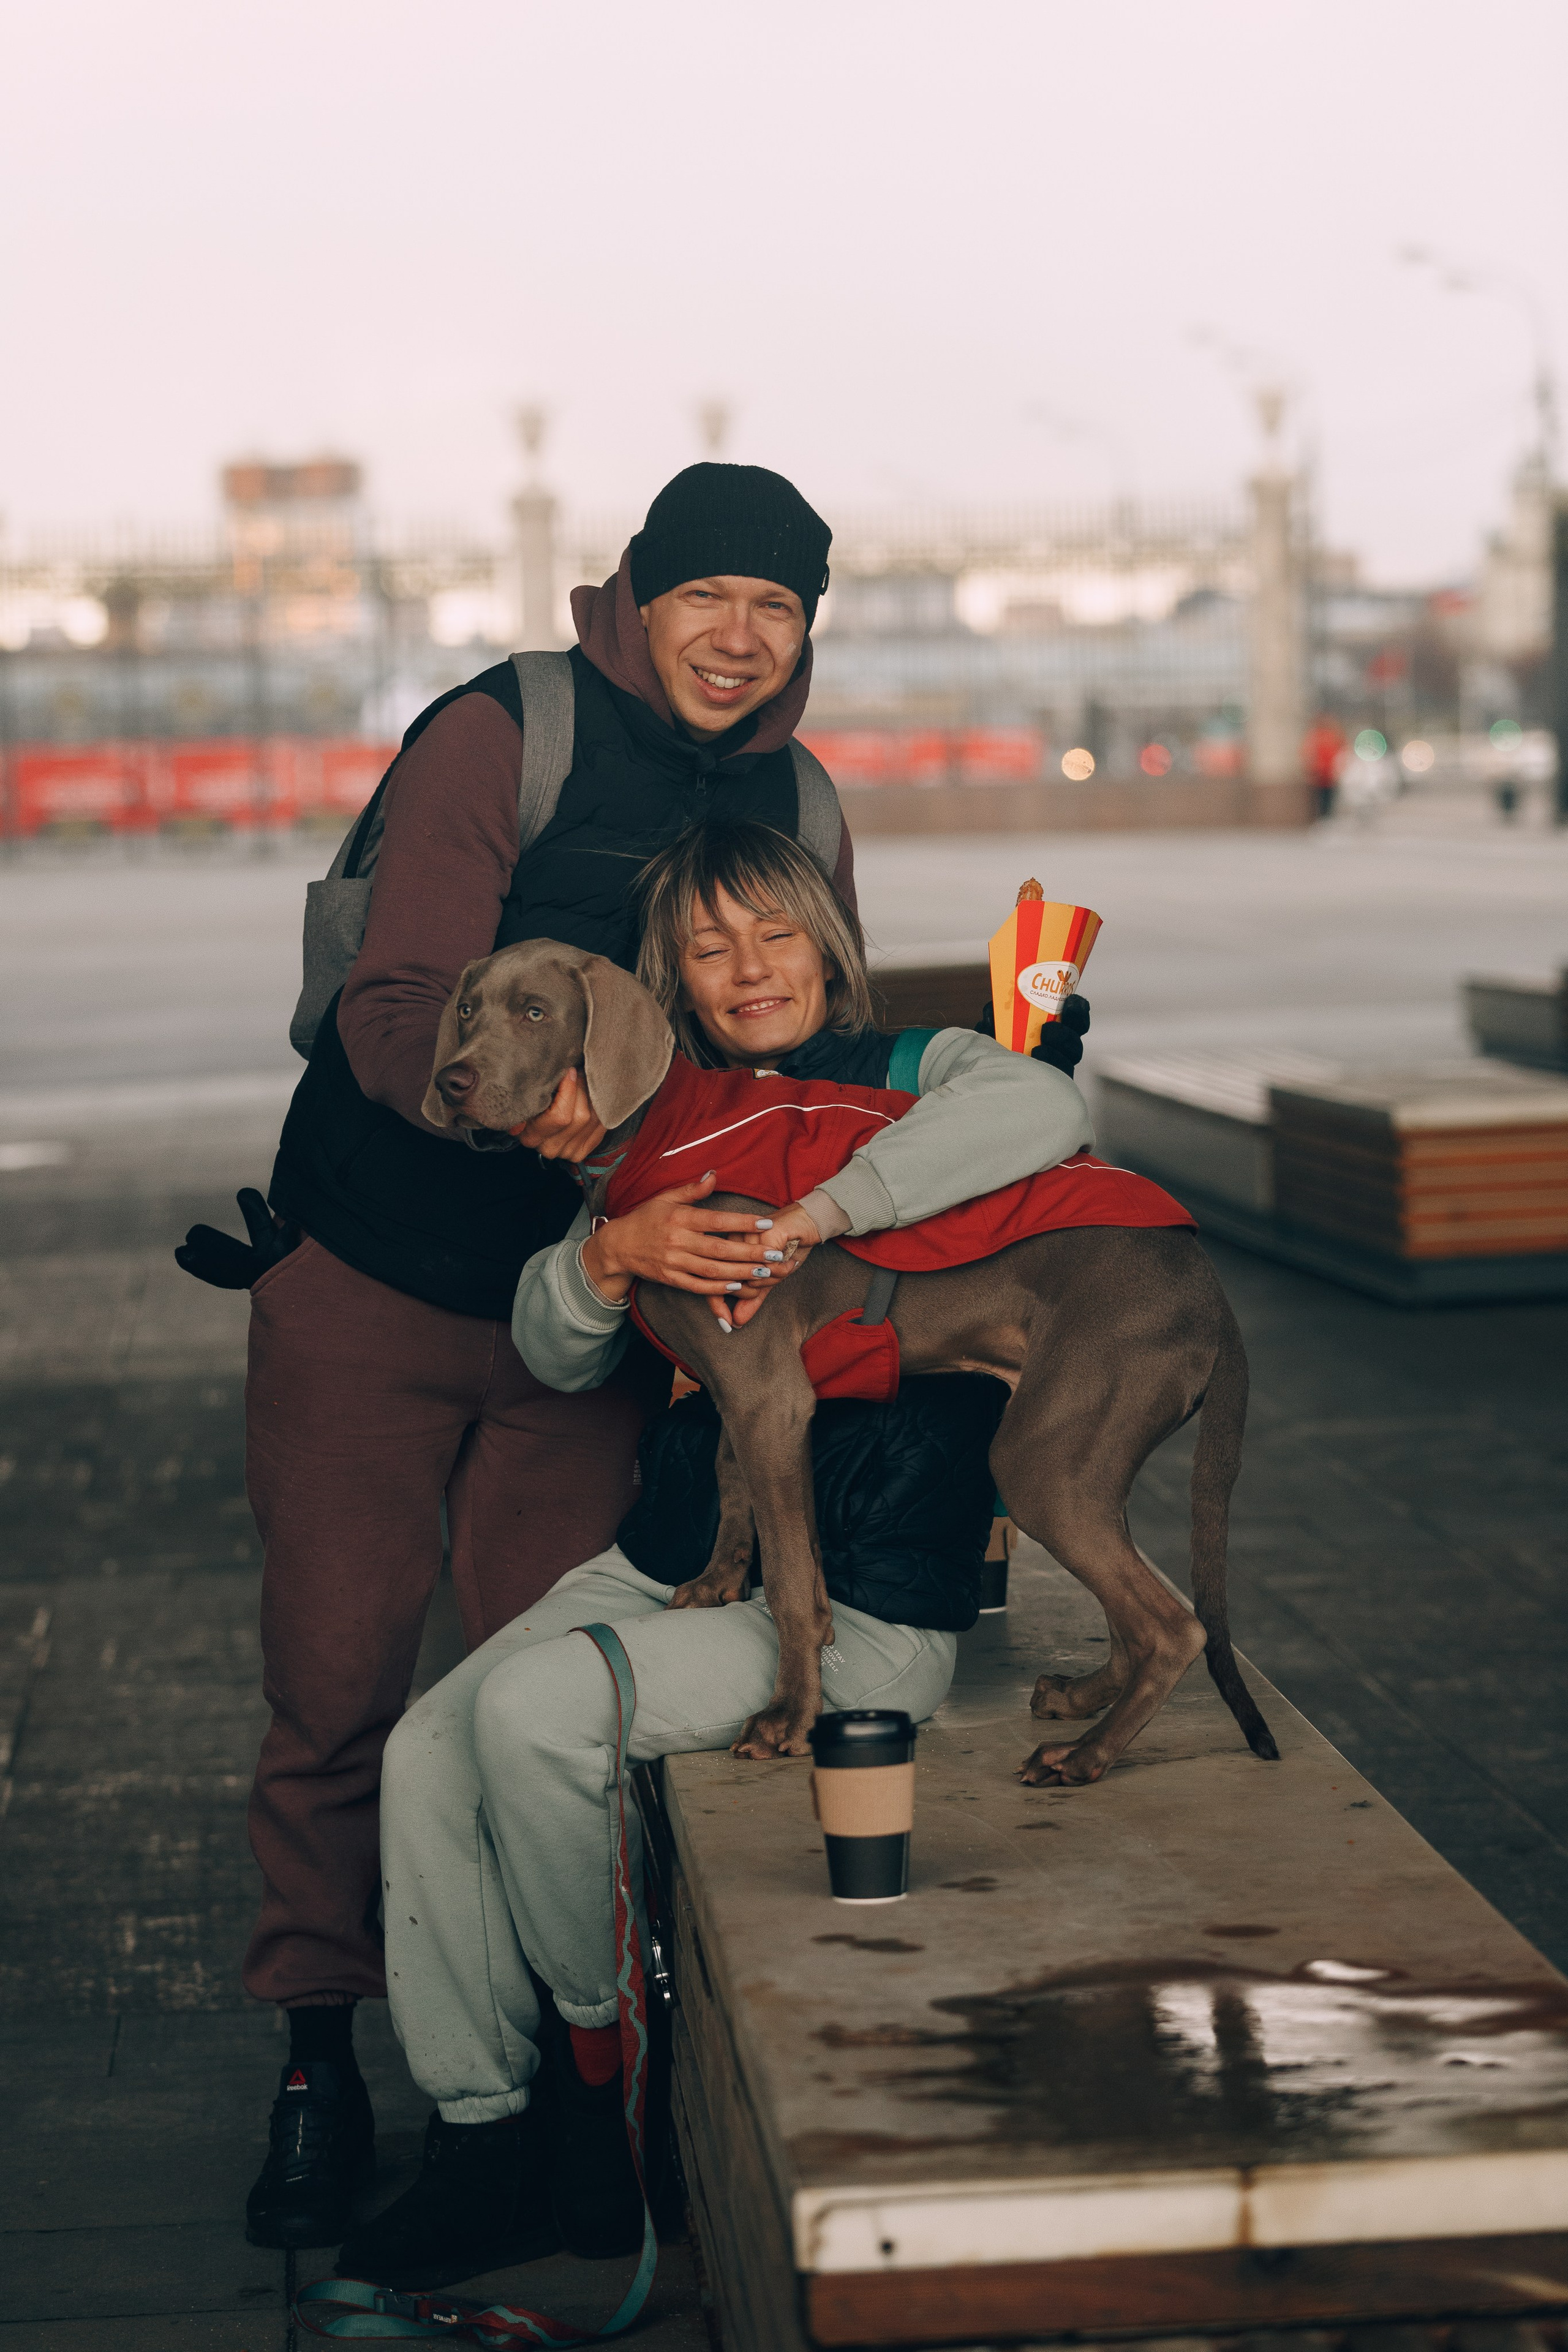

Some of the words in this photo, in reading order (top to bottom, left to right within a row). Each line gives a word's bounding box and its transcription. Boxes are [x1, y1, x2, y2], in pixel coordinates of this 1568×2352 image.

[822, 1645, 837, 1662] SHOW
[833, 1649, 845, 1663] STAY
[821, 1651, 839, 1674] URSELF.
